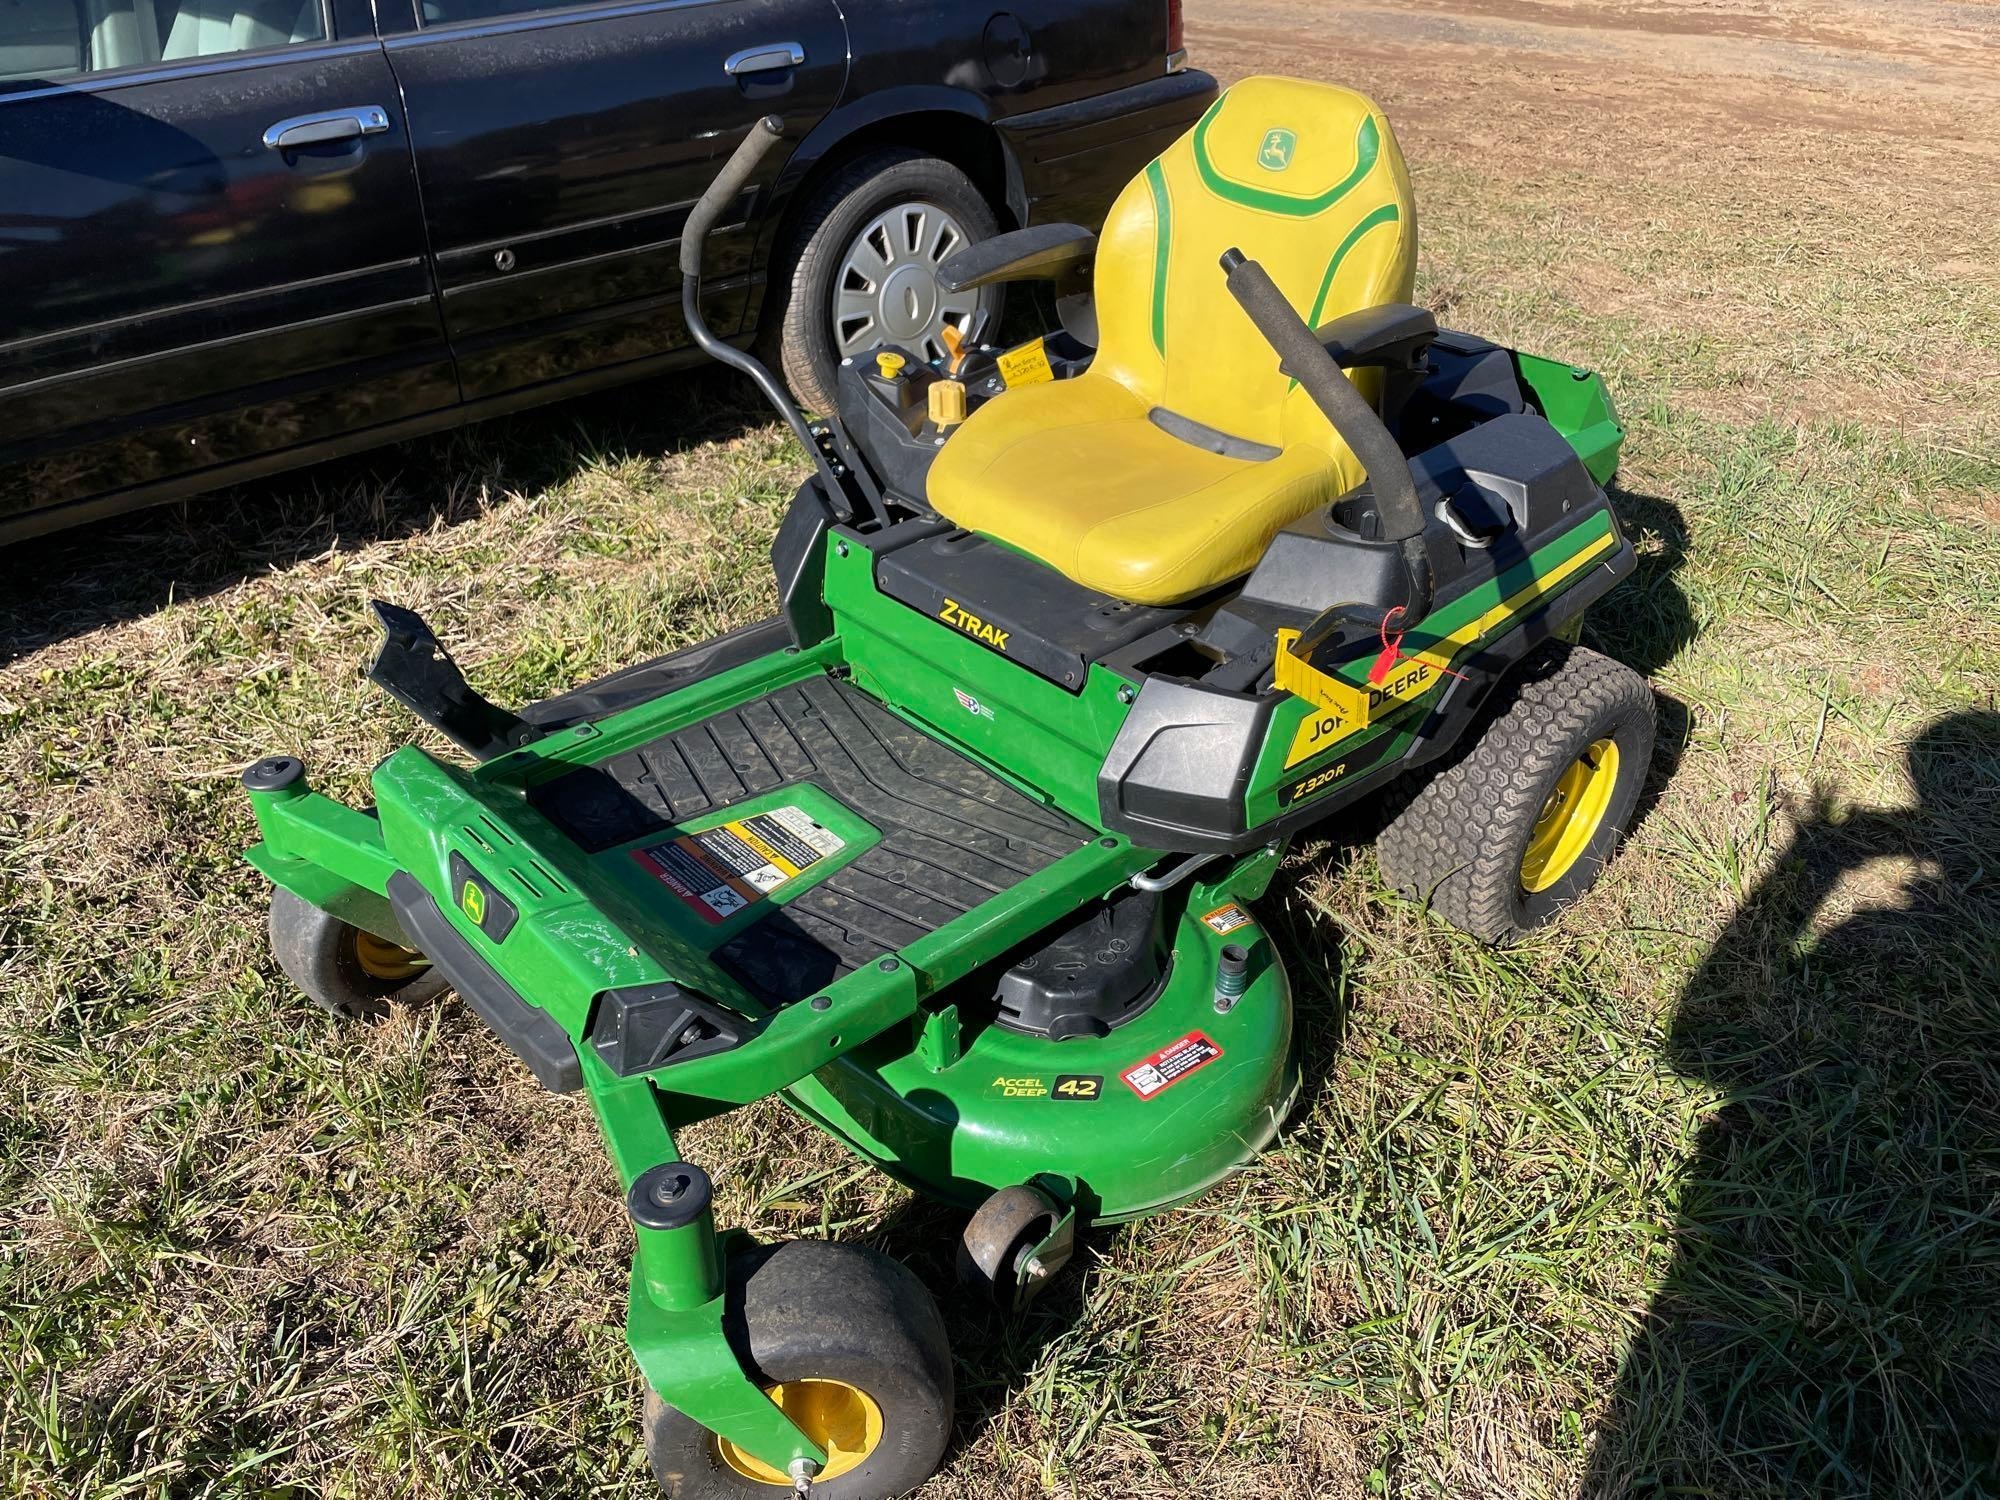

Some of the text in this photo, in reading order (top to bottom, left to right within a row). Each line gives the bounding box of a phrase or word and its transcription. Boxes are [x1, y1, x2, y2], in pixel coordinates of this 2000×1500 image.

[940, 598, 1009, 650] ZTRAK
[1310, 716, 1348, 742] JO
[1369, 664, 1429, 710] DEERE
[1293, 763, 1346, 799] Z320R
[660, 873, 687, 893] DANGER
[1164, 1039, 1190, 1055] DANGER
[992, 1077, 1097, 1095] ACCEL 42
[1003, 1087, 1047, 1096] DEEP
